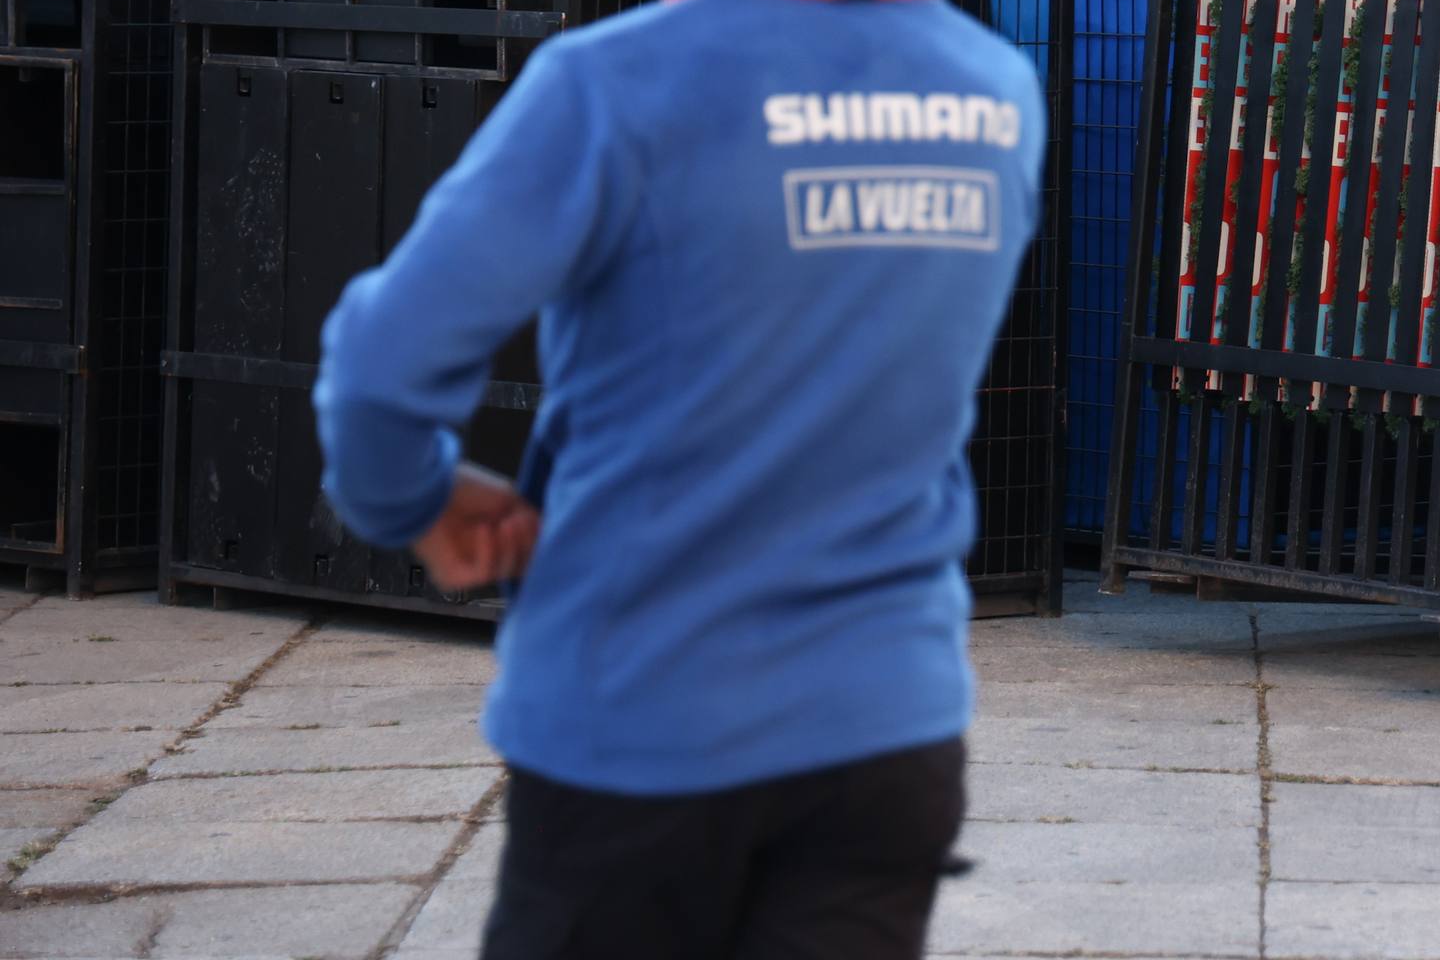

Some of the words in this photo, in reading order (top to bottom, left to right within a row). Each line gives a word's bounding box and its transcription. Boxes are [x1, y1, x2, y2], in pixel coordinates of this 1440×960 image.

[763, 92, 1020, 148] SHIMANO
[804, 183, 854, 234] LA
[857, 180, 986, 234] VUELTA
